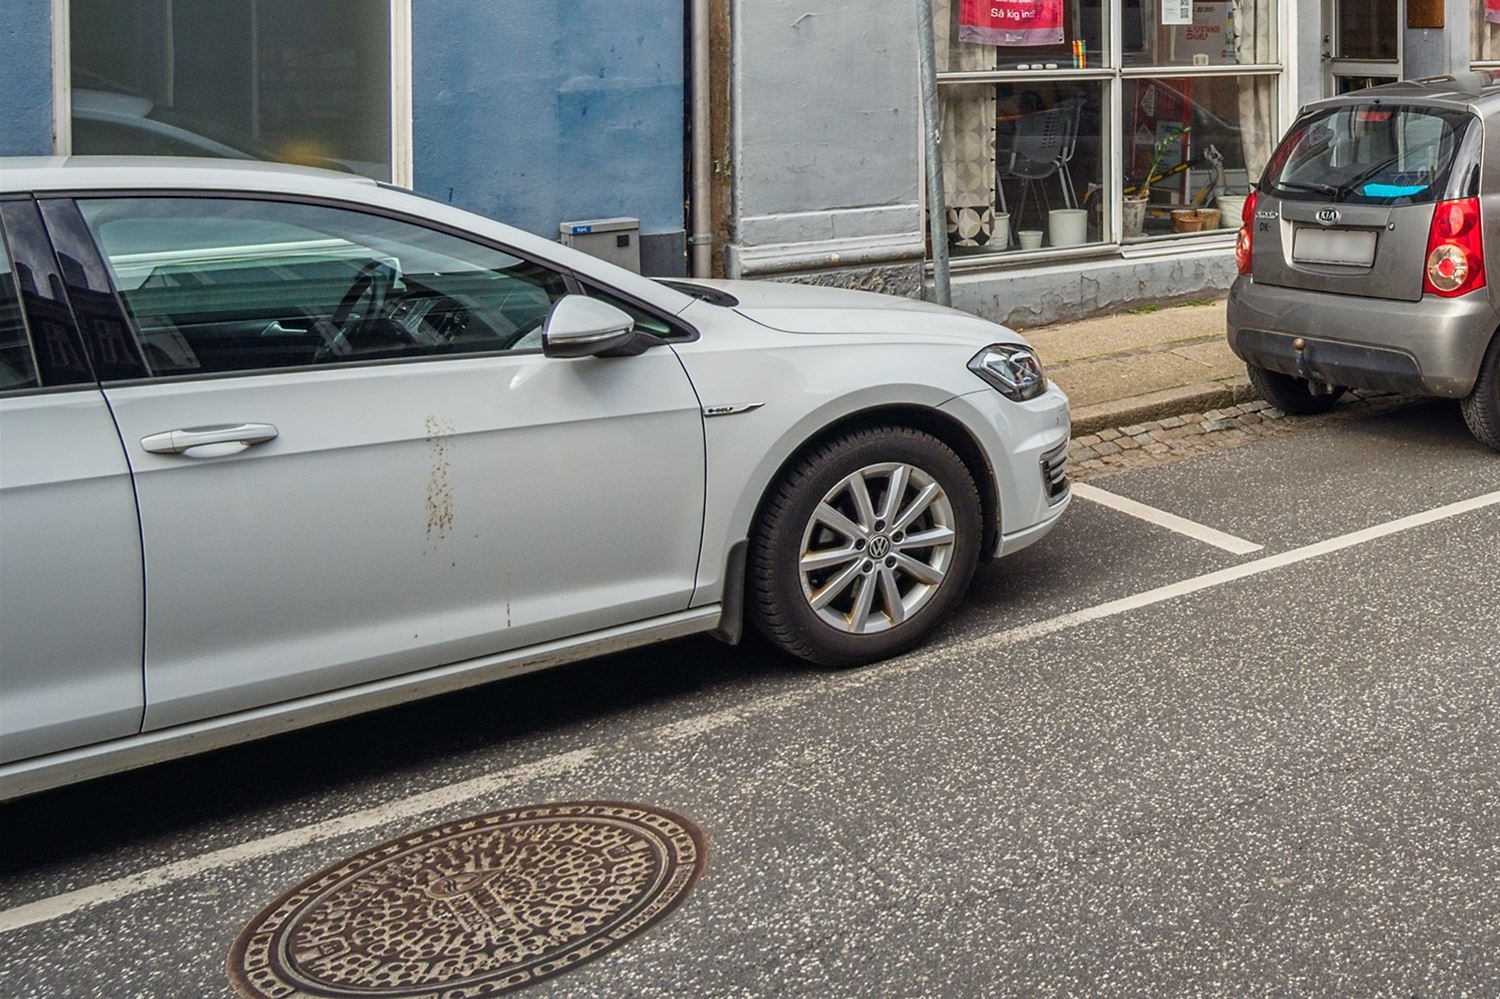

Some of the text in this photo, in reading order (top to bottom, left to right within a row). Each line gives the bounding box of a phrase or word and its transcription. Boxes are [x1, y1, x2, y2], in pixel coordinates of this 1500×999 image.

[990, 7, 1004, 18] Så
[1007, 8, 1020, 21] kig
[1320, 210, 1336, 220] KIA
